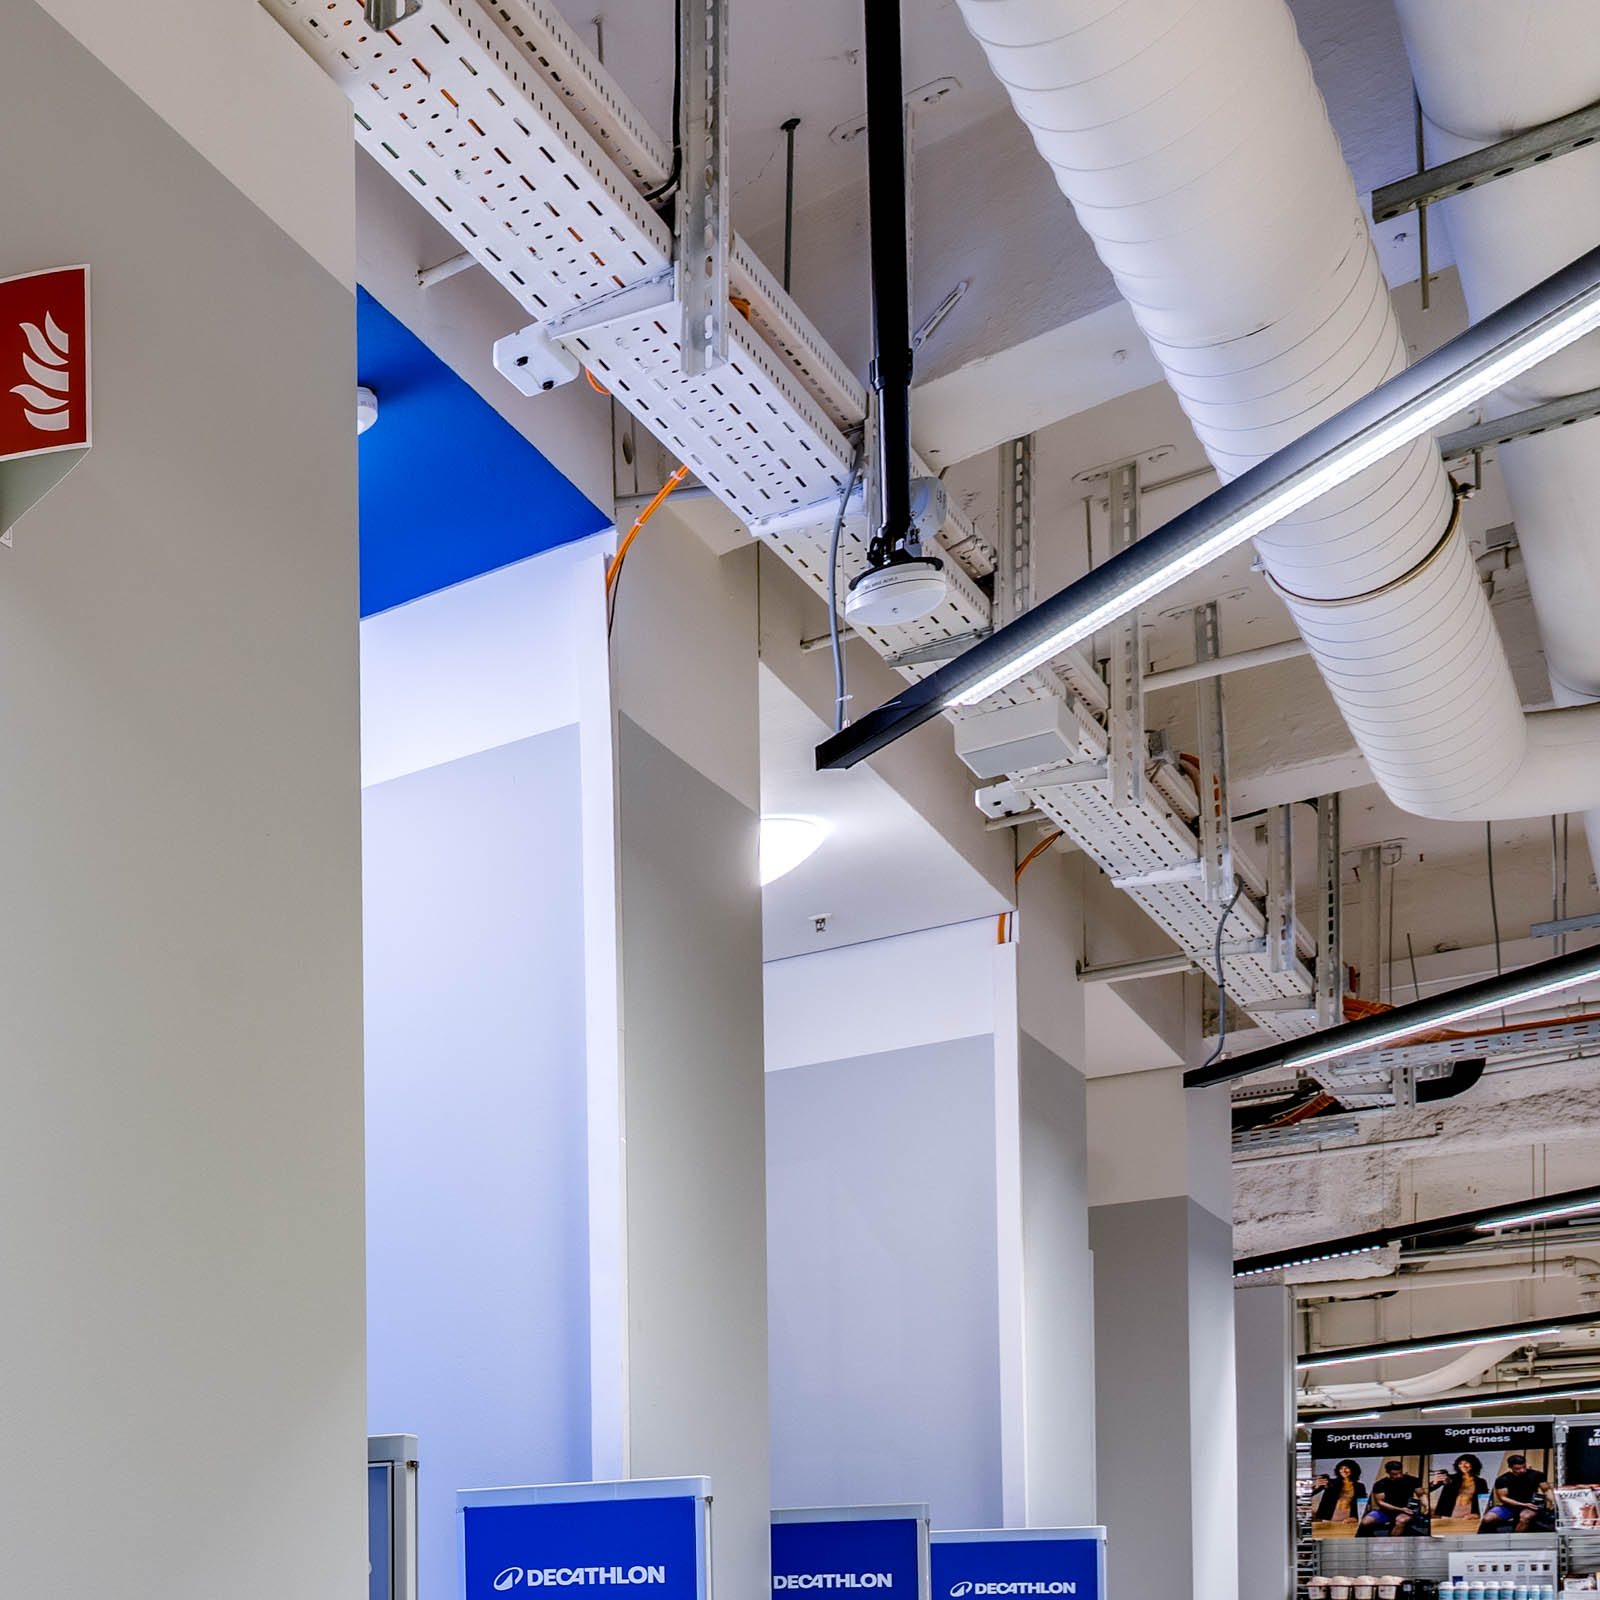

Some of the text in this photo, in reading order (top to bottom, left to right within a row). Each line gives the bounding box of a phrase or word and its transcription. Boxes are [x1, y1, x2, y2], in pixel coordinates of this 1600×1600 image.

[1327, 1431, 1412, 1443] Sporternährung
[1444, 1424, 1535, 1437] Sporternährung
[1349, 1440, 1389, 1450] Fitness
[1469, 1434, 1511, 1444] Fitness
[527, 1565, 666, 1587] DECATHLON
[773, 1573, 892, 1591] DECATHLON
[974, 1581, 1076, 1595] DECATHLON
